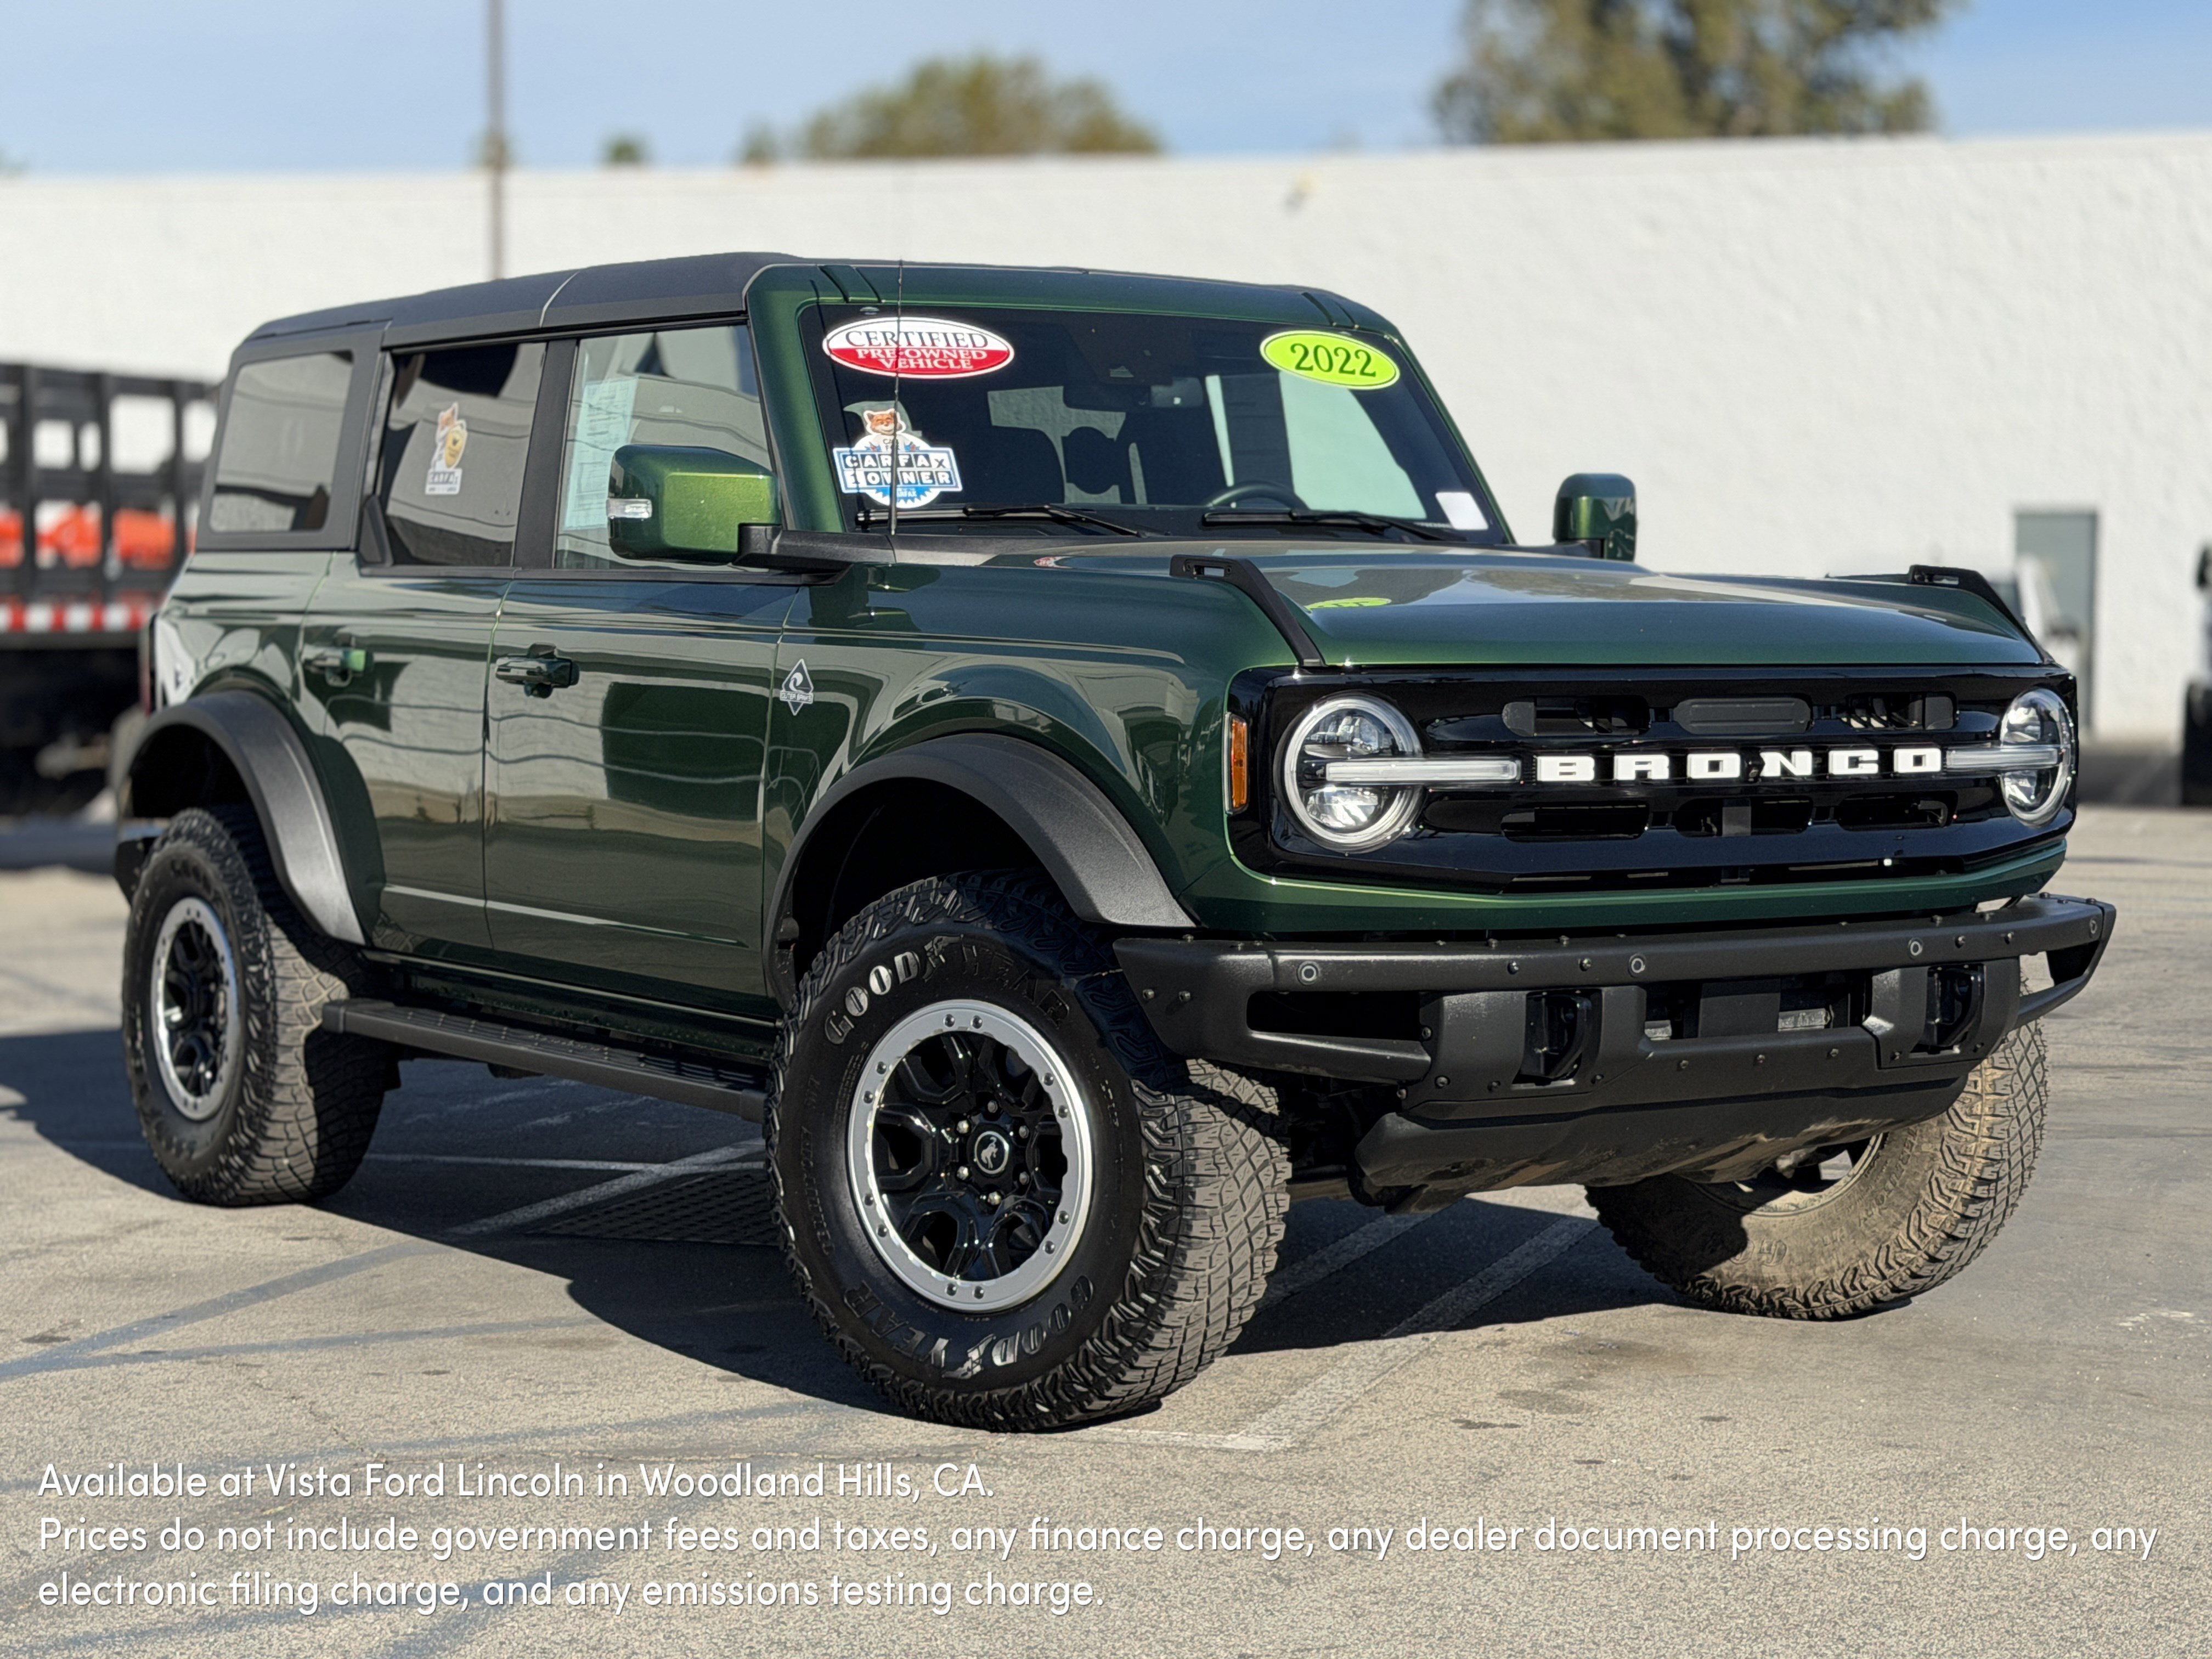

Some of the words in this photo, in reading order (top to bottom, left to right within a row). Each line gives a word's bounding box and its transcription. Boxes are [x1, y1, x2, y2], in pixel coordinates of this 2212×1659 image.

[845, 330, 988, 348] CERTIFIED
[855, 348, 988, 360] PRE-OWNED
[1290, 343, 1376, 377] 2022
[878, 358, 974, 369] VEHICLE
[845, 454, 946, 469] CARFAX
[1536, 748, 1942, 782] BRONCO
